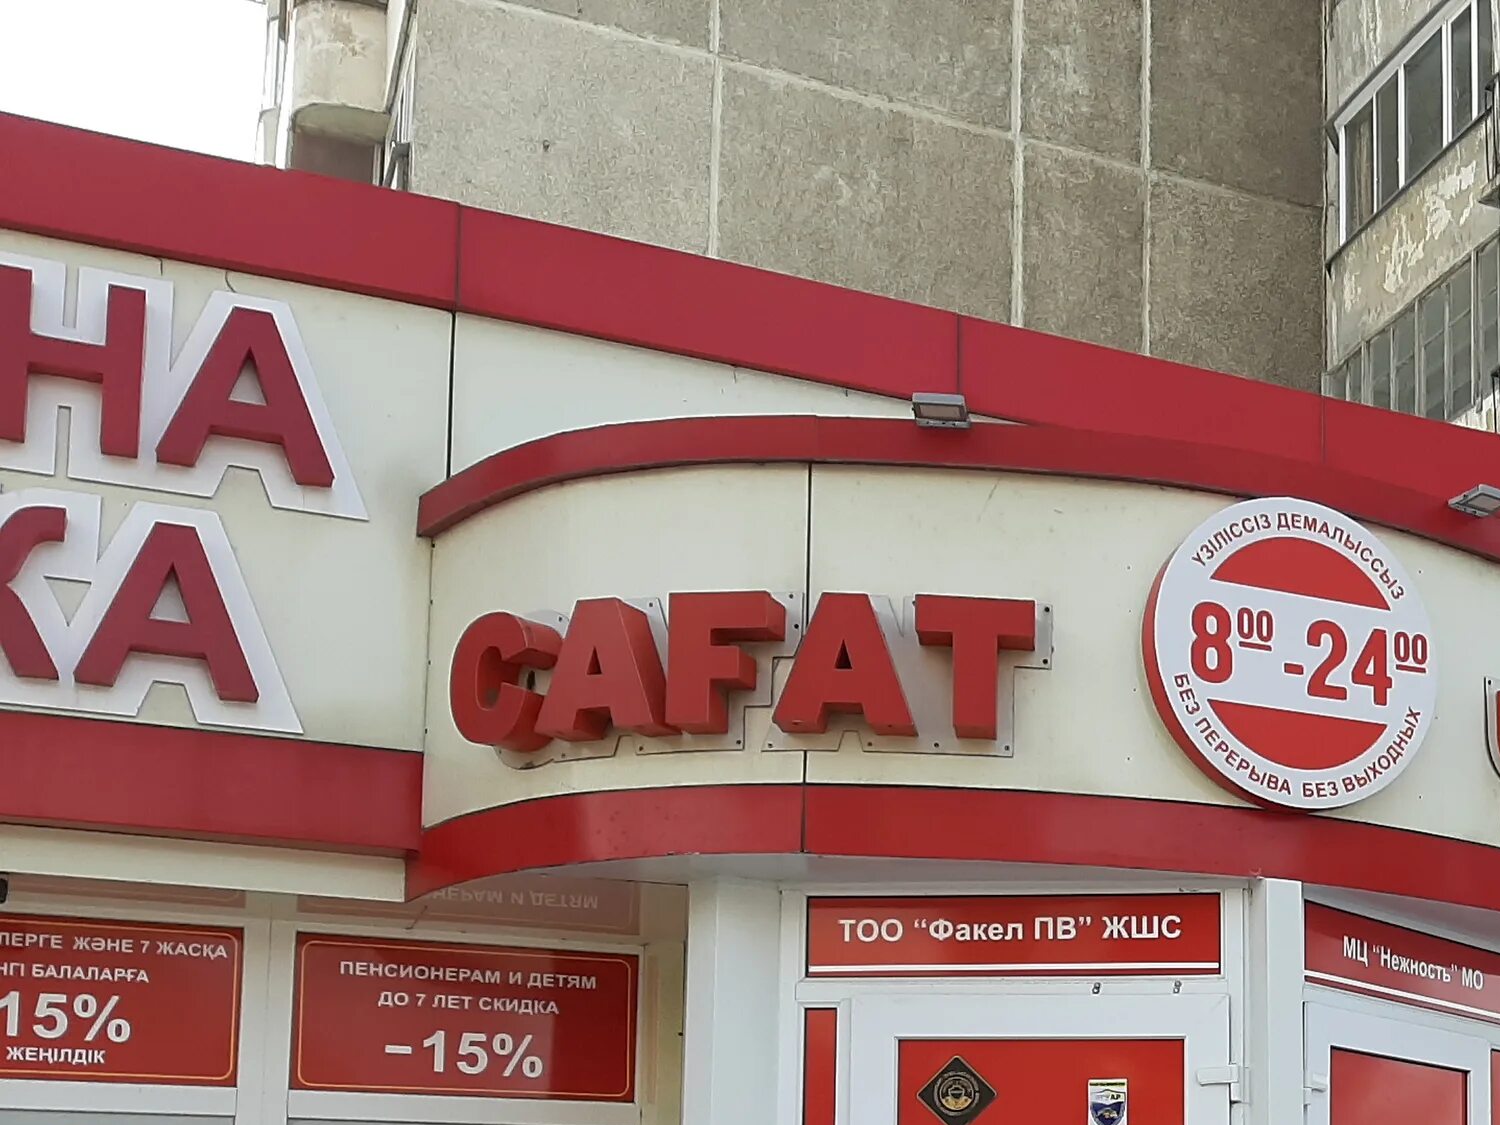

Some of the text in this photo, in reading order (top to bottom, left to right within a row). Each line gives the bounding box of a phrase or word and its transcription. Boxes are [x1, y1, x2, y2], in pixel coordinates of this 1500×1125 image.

[1277, 511, 1405, 600] ДЕМАЛЫССЫЗ
[1173, 673, 1422, 799] БЕЗ ПЕРЕРЫВА БЕЗ ВЫХОДНЫХ
[838, 918, 904, 943] ТОО
[1102, 914, 1182, 940] ЖШС
[73, 935, 134, 953] ЖӘНЕ
[140, 940, 151, 954] 7
[156, 940, 228, 961] ЖАСҚА
[31, 963, 149, 983] БАЛАЛАРҒА
[339, 961, 597, 990] ПЕНСИОНЕРАМ И ДЕТЯМ
[1343, 935, 1369, 968] МЦ
[1461, 966, 1484, 991] МО
[377, 991, 560, 1016] ДО 7 ЛЕТ СКИДКА
